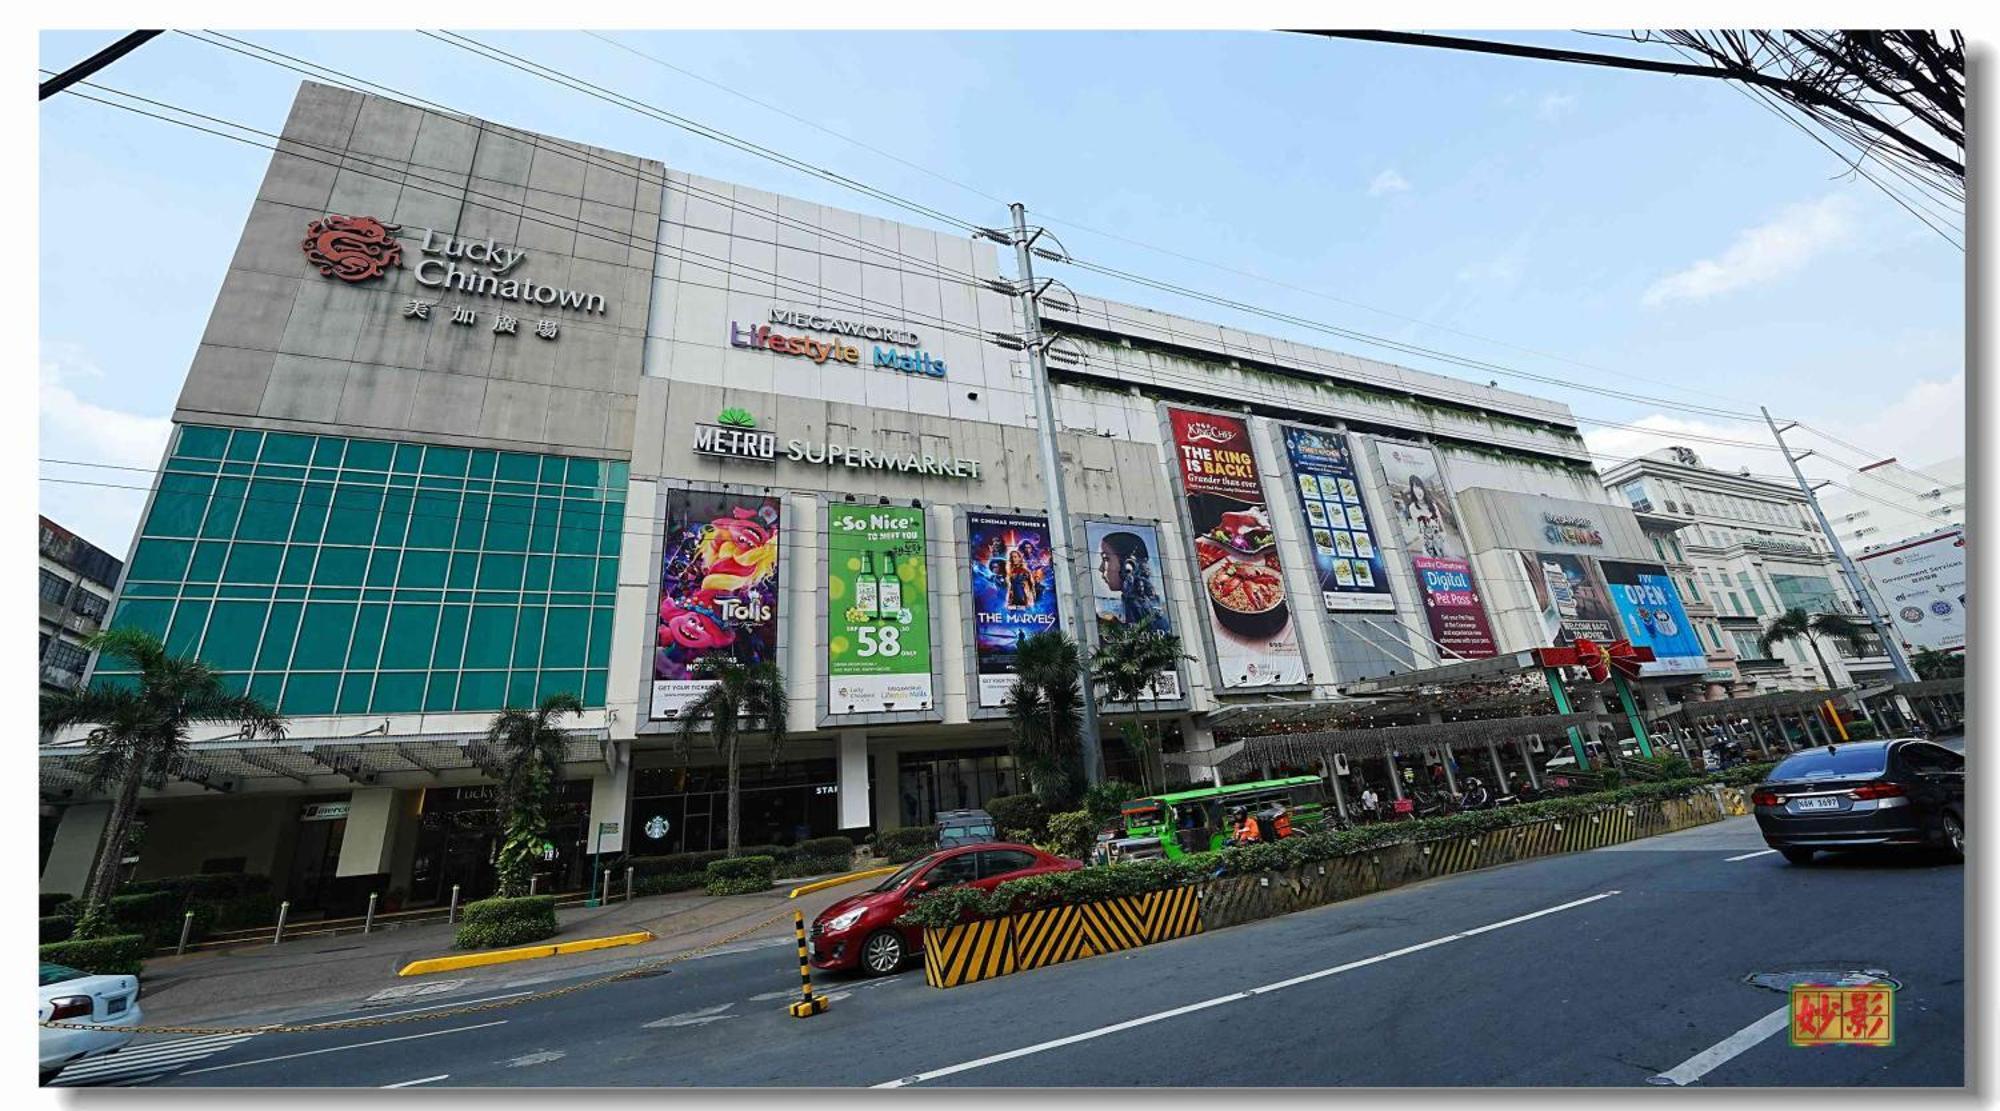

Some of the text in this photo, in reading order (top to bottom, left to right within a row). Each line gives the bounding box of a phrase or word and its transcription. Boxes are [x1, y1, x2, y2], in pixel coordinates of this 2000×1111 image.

[420, 228, 526, 275] Lucky
[413, 260, 606, 314] Chinatown
[768, 308, 921, 346] MEGAWORLD
[731, 321, 947, 377] Lifestyle Malls
[692, 426, 981, 479] METRO SUPERMARKET
[1181, 445, 1251, 465] THE KING
[1187, 459, 1253, 478] IS BACK!
[842, 515, 867, 531] So
[1426, 572, 1468, 590] Digital
[1882, 568, 1928, 584] Government
[1436, 592, 1450, 604] Pet
[1624, 584, 1668, 605] OPEN
[714, 598, 772, 622] Trolls
[978, 612, 1056, 632] THE MARVELS
[857, 625, 901, 657] 58
